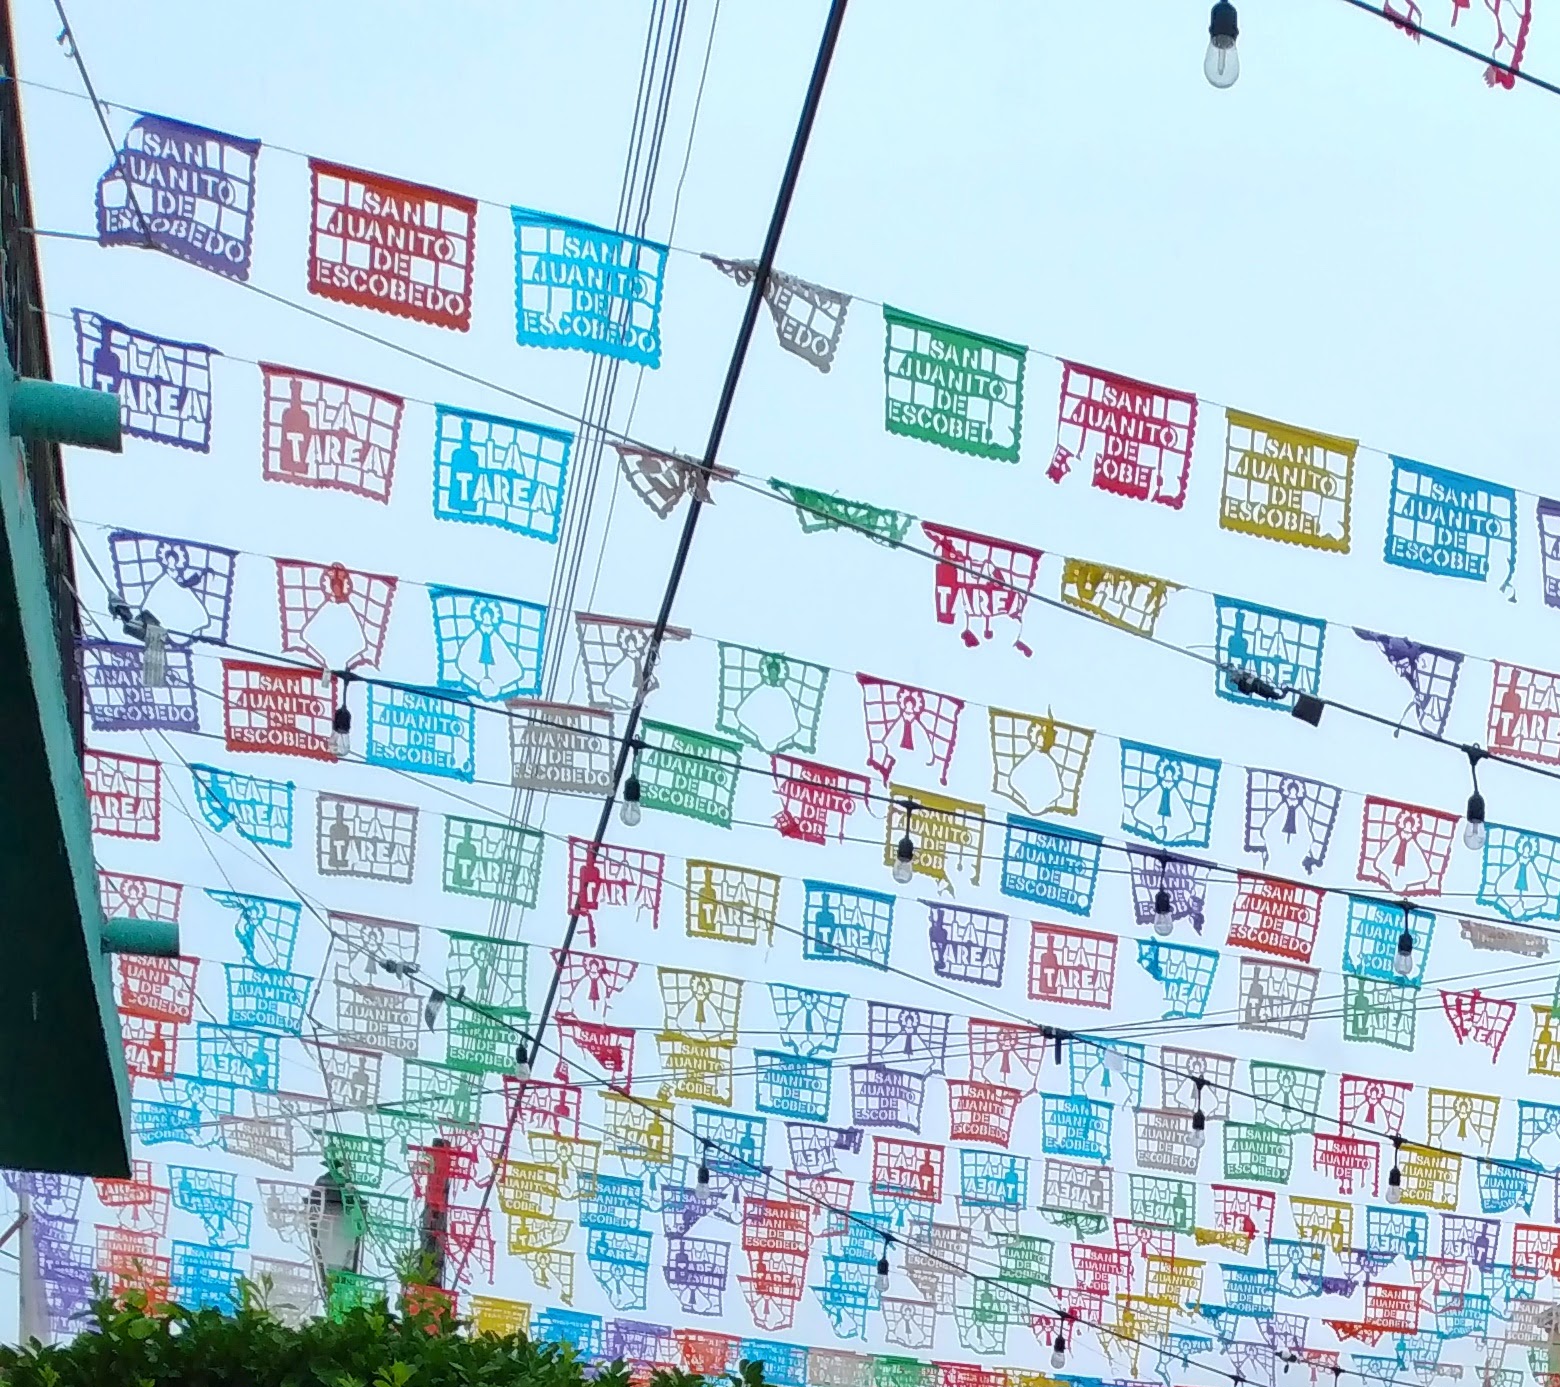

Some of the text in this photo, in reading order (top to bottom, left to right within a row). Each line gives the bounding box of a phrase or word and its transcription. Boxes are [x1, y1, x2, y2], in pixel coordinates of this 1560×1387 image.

[142, 132, 202, 168] SAN
[157, 190, 195, 218] DE
[362, 191, 425, 227] SAN
[105, 208, 245, 264] ESCOBEDO
[327, 208, 455, 260] JUANITO
[564, 236, 620, 266] SAN
[373, 253, 410, 276] DE
[315, 259, 464, 316] ESCOBEDO
[533, 260, 649, 299] JUANITO
[576, 290, 607, 314] DE
[523, 313, 656, 353] ESCOBEDO
[127, 341, 175, 382] LA
[929, 338, 980, 371] SAN
[898, 355, 1008, 401] JUANITO
[94, 373, 208, 422] TAREA
[935, 386, 967, 415] DE
[1102, 383, 1152, 416] SAN
[316, 398, 355, 436] LA
[1072, 402, 1178, 448] JUANITO
[288, 432, 388, 478] TAREA
[487, 438, 526, 474] LA
[1107, 435, 1139, 461] DE
[1264, 438, 1314, 466] SAN
[1237, 454, 1337, 497] JUANITO
[456, 472, 556, 514] TAREA
[1271, 485, 1302, 510] DE
[1430, 482, 1476, 510] SAN
[1403, 495, 1503, 538] JUANITO
[1437, 526, 1467, 549] DE
[1253, 628, 1289, 662] LA
[259, 675, 301, 694] SAN
[236, 689, 325, 715] JUANITO
[402, 691, 442, 712] SAN
[1529, 685, 1560, 712] LA
[94, 704, 195, 721] ESCOBEDO
[270, 713, 296, 727] DE
[382, 708, 464, 735] JUANITO
[409, 731, 434, 747] DE
[520, 728, 602, 751] JUANITO
[672, 737, 710, 759] SAN
[548, 751, 573, 765] DE
[648, 751, 729, 786] JUANITO
[513, 764, 611, 786] ESCOBEDO
[675, 772, 698, 792] DE
[638, 782, 732, 819] ESCOBEDO
[778, 780, 856, 814] JUANITO
[803, 801, 826, 820] DE
[354, 816, 385, 839] LA
[333, 840, 408, 864] TAREA
[1036, 835, 1070, 853] SAN
[1016, 846, 1086, 874] JUANITO
[1038, 864, 1061, 884] DE
[1261, 884, 1295, 901] SAN
[702, 903, 770, 929] TAREA
[839, 904, 866, 926] LA
[1234, 894, 1310, 922] JUANITO
[1262, 914, 1283, 929] DE
[819, 926, 886, 949] TAREA
[1230, 924, 1312, 955] ESCOBEDO
[1061, 946, 1090, 967] LA
[252, 971, 286, 987] SAN
[1044, 967, 1108, 989] TAREA
[256, 997, 278, 1011] DE
[873, 1072, 902, 1085] SAN
[860, 1083, 917, 1101] JUANITO
[880, 1097, 899, 1108] DE
[1154, 1117, 1179, 1129] SAN
[1247, 1129, 1270, 1141] SAN
[1158, 1140, 1174, 1151] DE
[1233, 1141, 1285, 1156] JUANITO
[1332, 1142, 1356, 1154] SAN
[1138, 1152, 1196, 1168] ESCOBEDO
[1252, 1153, 1267, 1164] DE
[1318, 1154, 1371, 1169] JUANITO
[1336, 1166, 1352, 1177] DE
